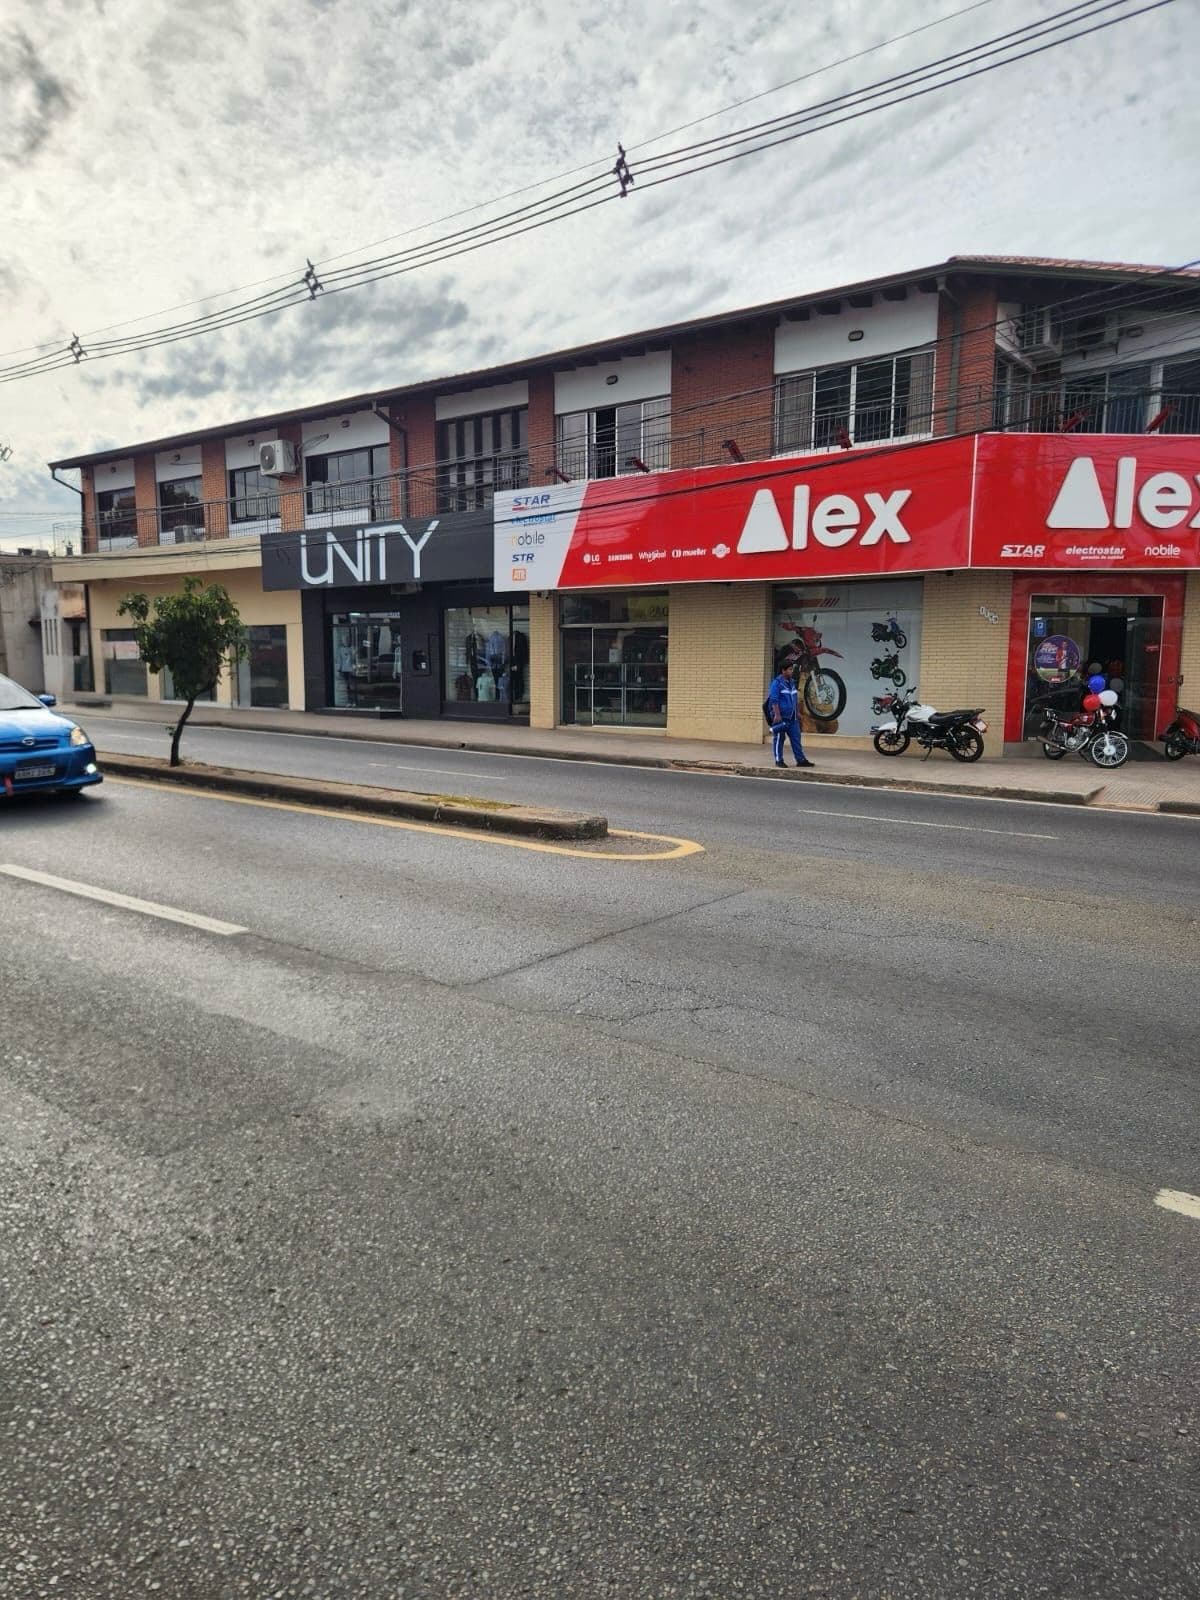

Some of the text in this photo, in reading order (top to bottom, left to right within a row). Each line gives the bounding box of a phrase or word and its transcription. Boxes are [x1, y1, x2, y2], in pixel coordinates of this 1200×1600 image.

[1046, 456, 1200, 529] Ale
[512, 494, 551, 508] STAR
[736, 484, 912, 555] Alex
[1000, 543, 1181, 556] STAR electrostar nobile
[512, 552, 535, 563] STR
[591, 554, 600, 562] LG
[608, 553, 633, 562] SAMSUNG
